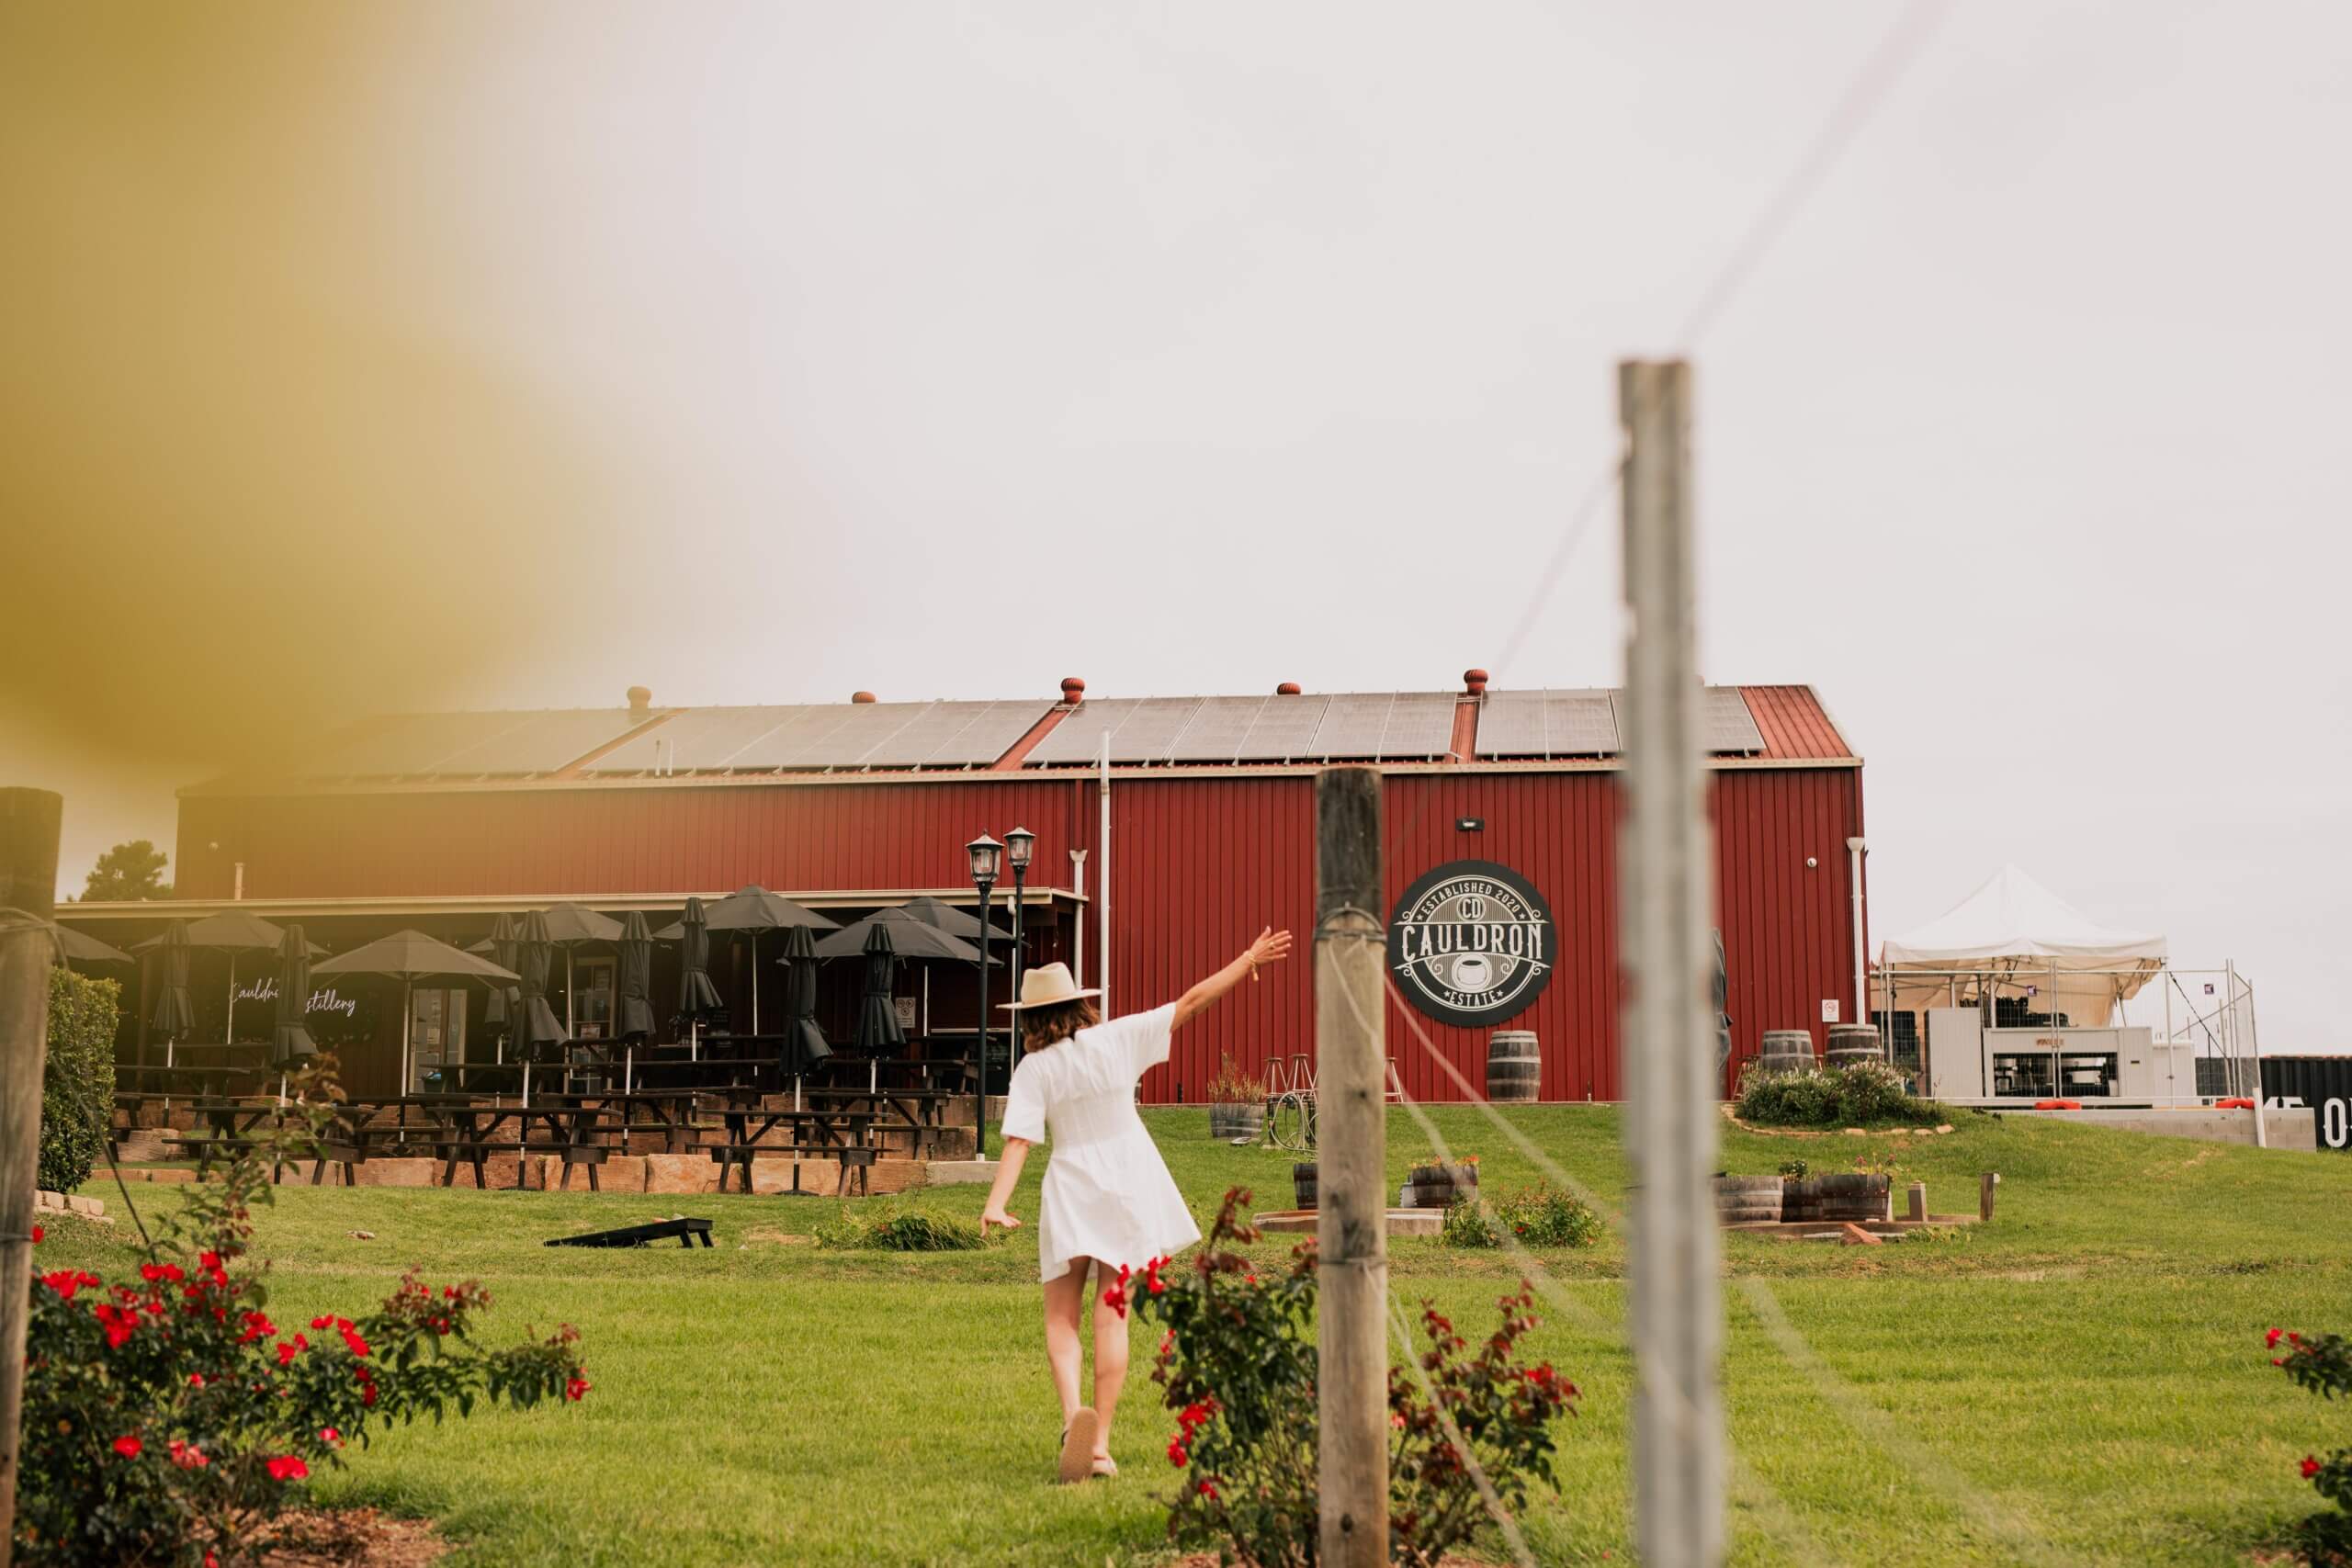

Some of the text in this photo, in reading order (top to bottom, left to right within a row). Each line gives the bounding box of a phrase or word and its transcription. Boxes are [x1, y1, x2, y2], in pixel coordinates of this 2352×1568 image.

[1421, 882, 1521, 915] ESTABLISHED 2020
[1462, 897, 1482, 919] CD
[1401, 923, 1543, 963] CAULDRON
[304, 988, 356, 1018] stillery
[1448, 989, 1499, 1008] ESTATE
